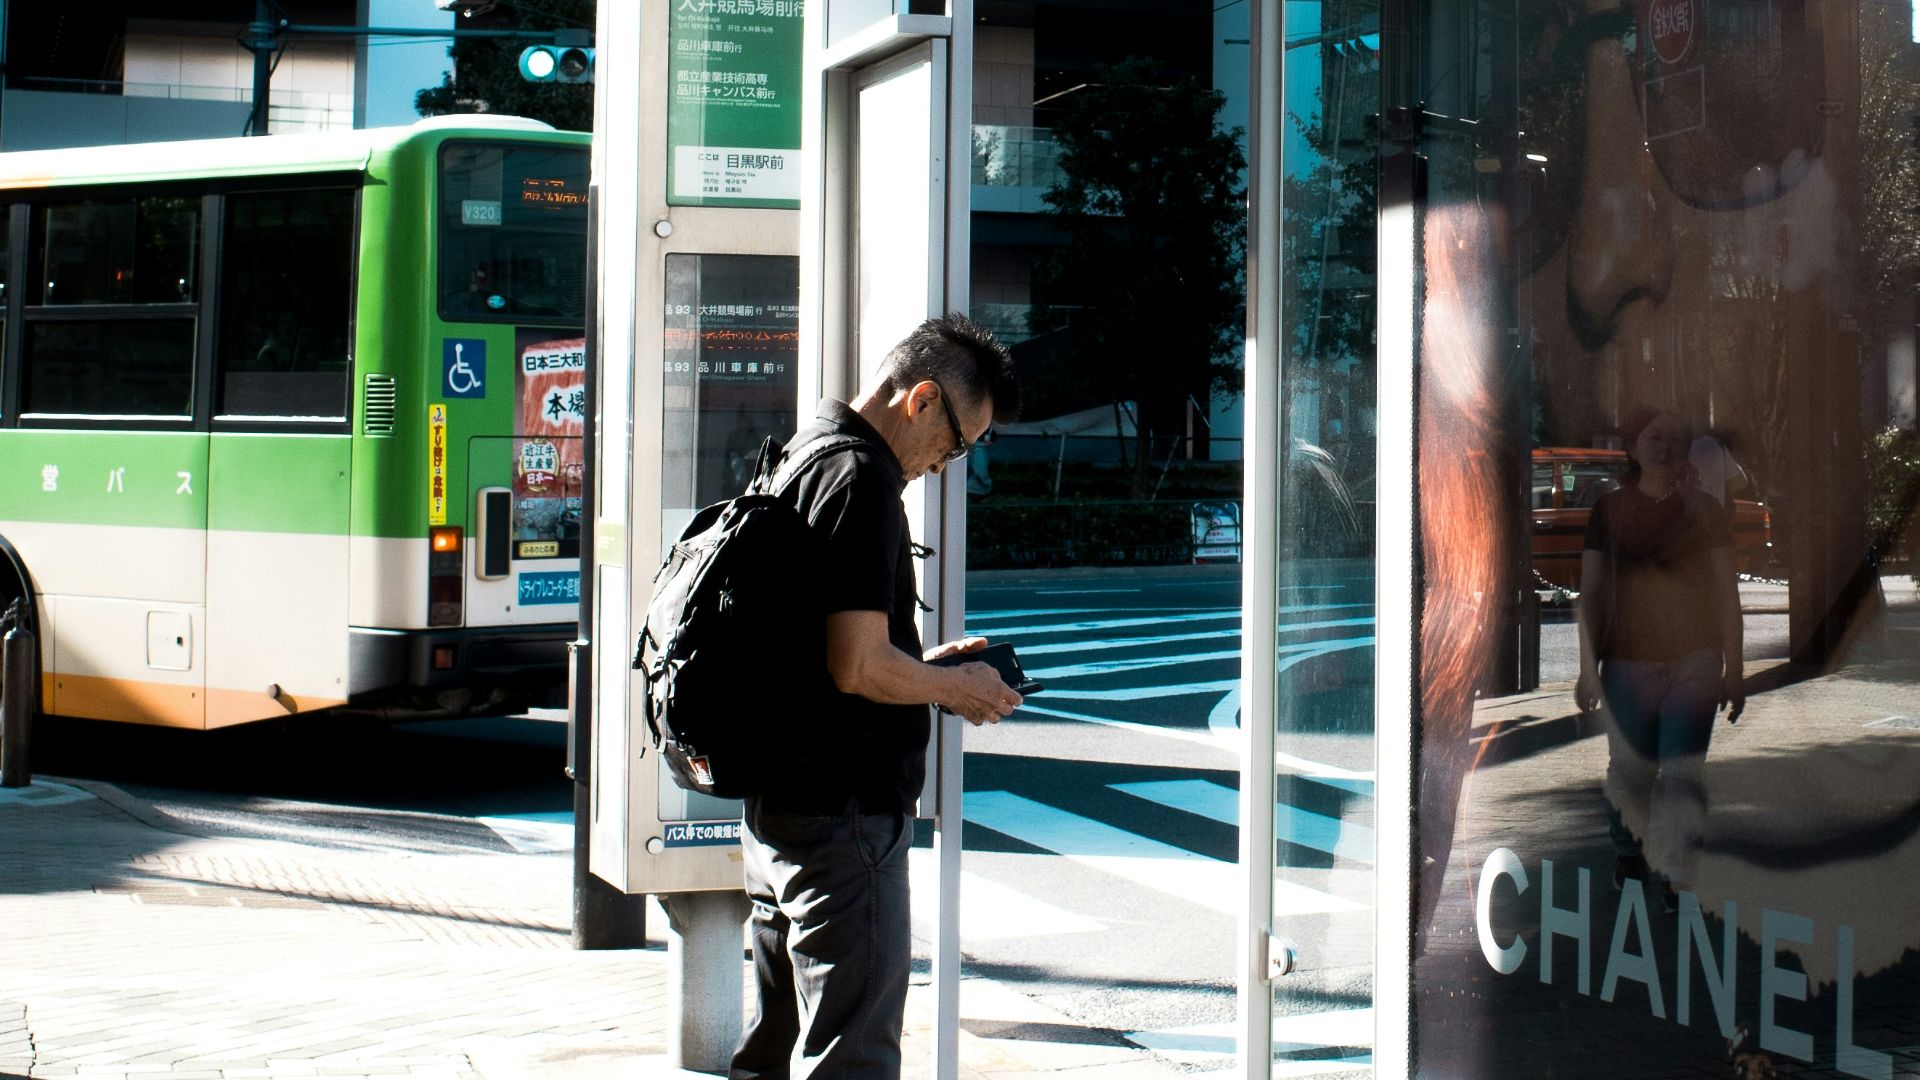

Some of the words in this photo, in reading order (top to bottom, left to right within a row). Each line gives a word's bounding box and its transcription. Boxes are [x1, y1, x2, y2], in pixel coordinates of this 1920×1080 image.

[677, 39, 742, 54] 品川車庫前行
[677, 70, 768, 86] 都立産業技術高専
[677, 84, 776, 100] 品川キャンパス前行
[727, 153, 784, 170] 目黒駅前
[464, 206, 495, 220] V320
[525, 352, 585, 371] 日本三大和
[525, 444, 556, 457] 近江牛
[526, 472, 554, 485] 日本一
[667, 824, 741, 841] バス停での喫煙は
[1476, 847, 1893, 1080] CHANEL
